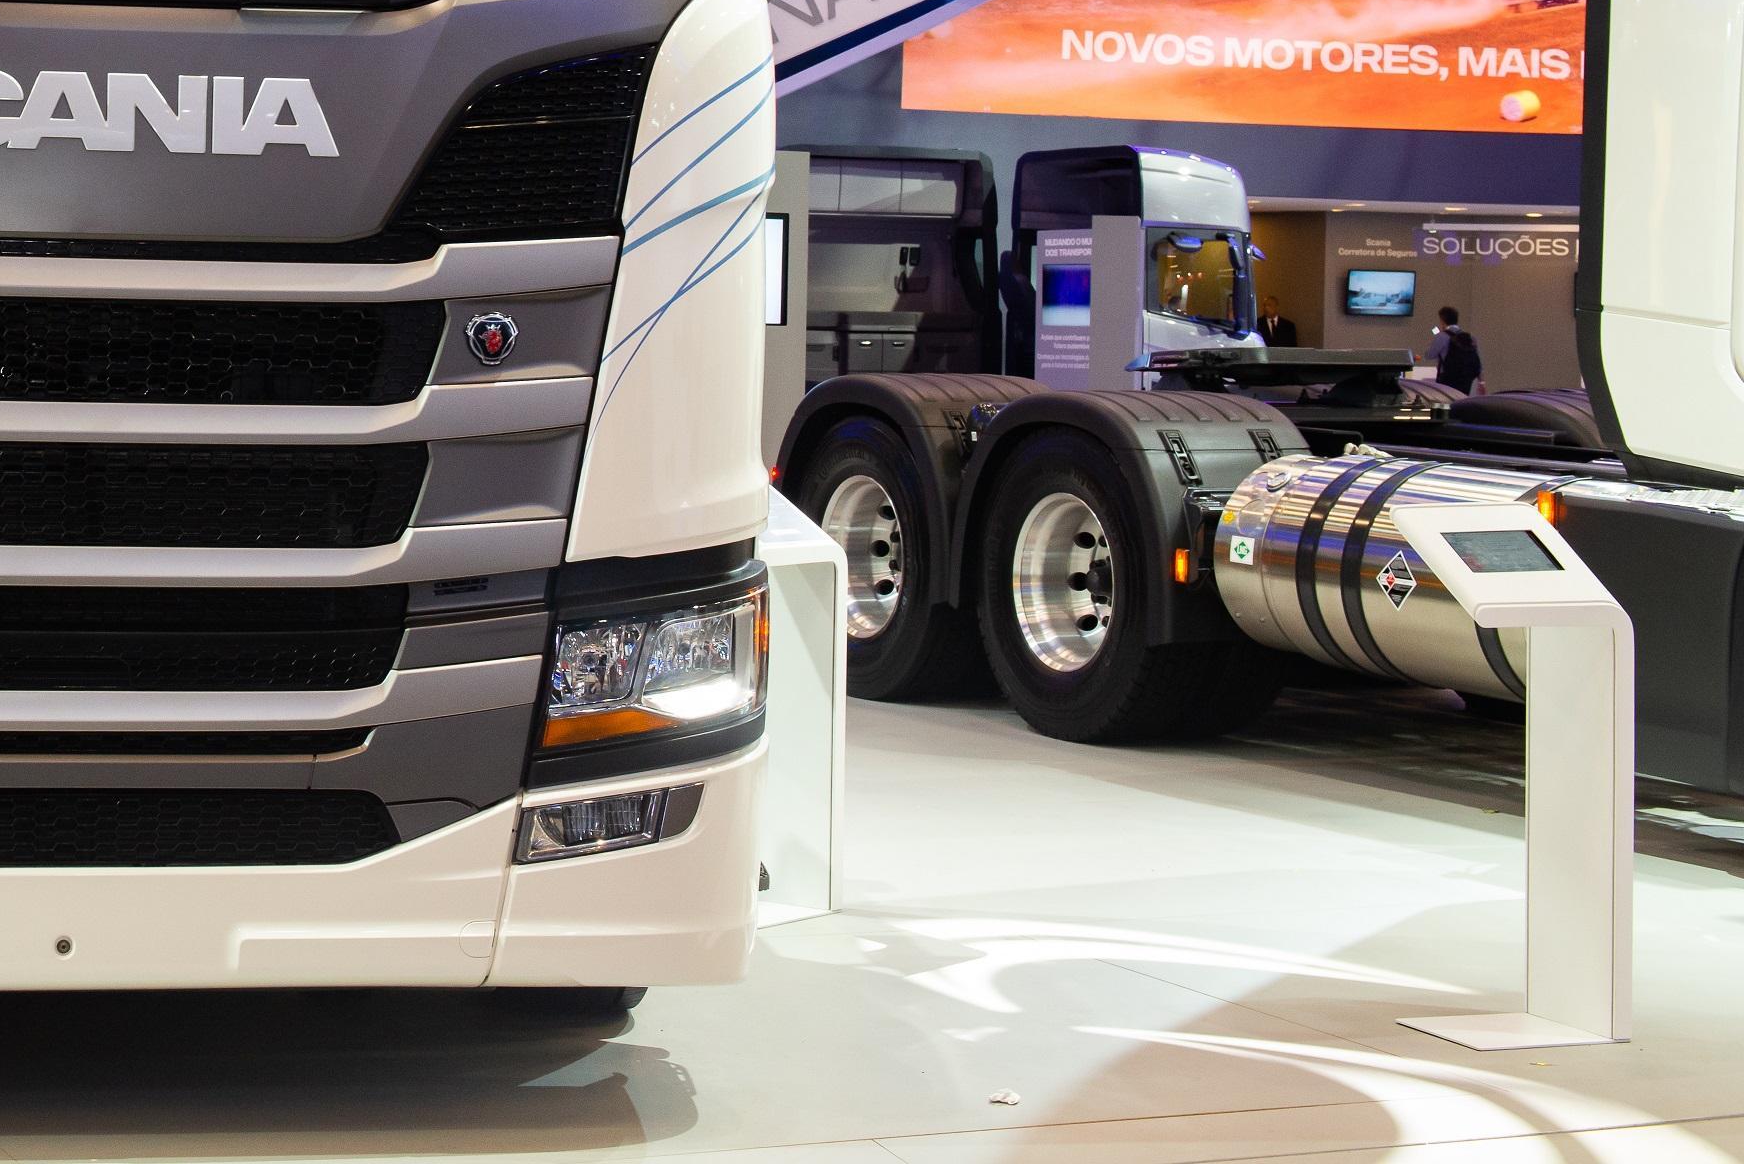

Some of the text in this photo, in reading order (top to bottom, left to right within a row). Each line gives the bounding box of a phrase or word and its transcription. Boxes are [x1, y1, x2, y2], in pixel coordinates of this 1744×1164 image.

[1061, 29, 1215, 67] NOVOS
[1223, 37, 1450, 82] MOTORES,
[1458, 46, 1572, 81] MAIS
[1422, 235, 1569, 259] SOLUÇÕES
